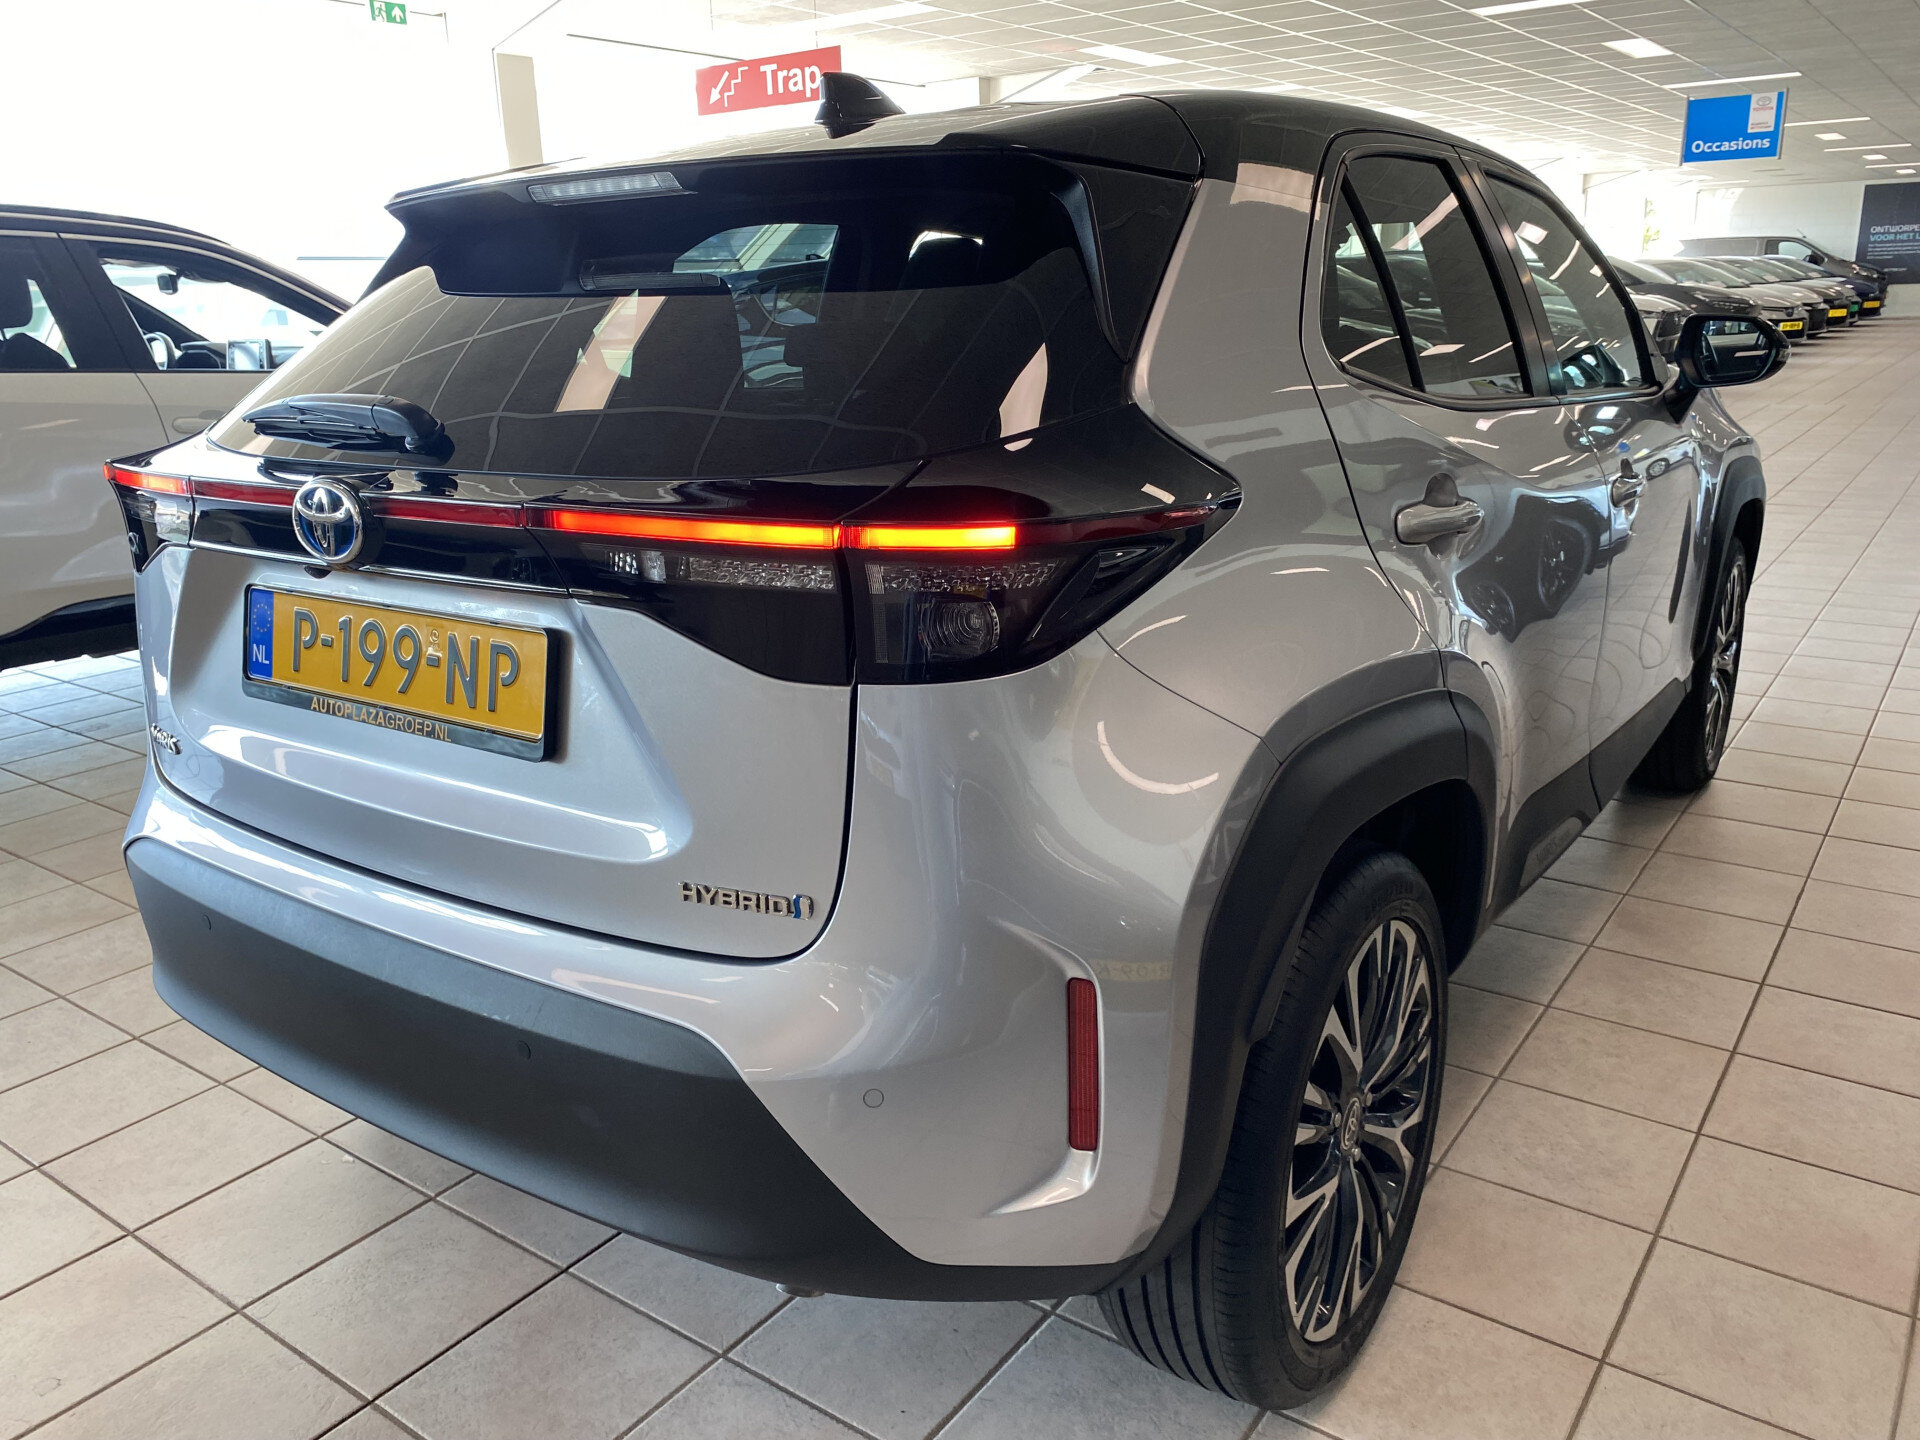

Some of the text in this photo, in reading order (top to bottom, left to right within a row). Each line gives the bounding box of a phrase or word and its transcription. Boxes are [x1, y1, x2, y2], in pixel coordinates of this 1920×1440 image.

[760, 63, 821, 98] Trap
[1691, 137, 1770, 153] Occasions
[252, 643, 270, 665] NL
[292, 606, 520, 713] P-199-NP
[310, 696, 452, 742] AUTOPLAZAGROEP.NL
[678, 881, 791, 917] HYBRID
